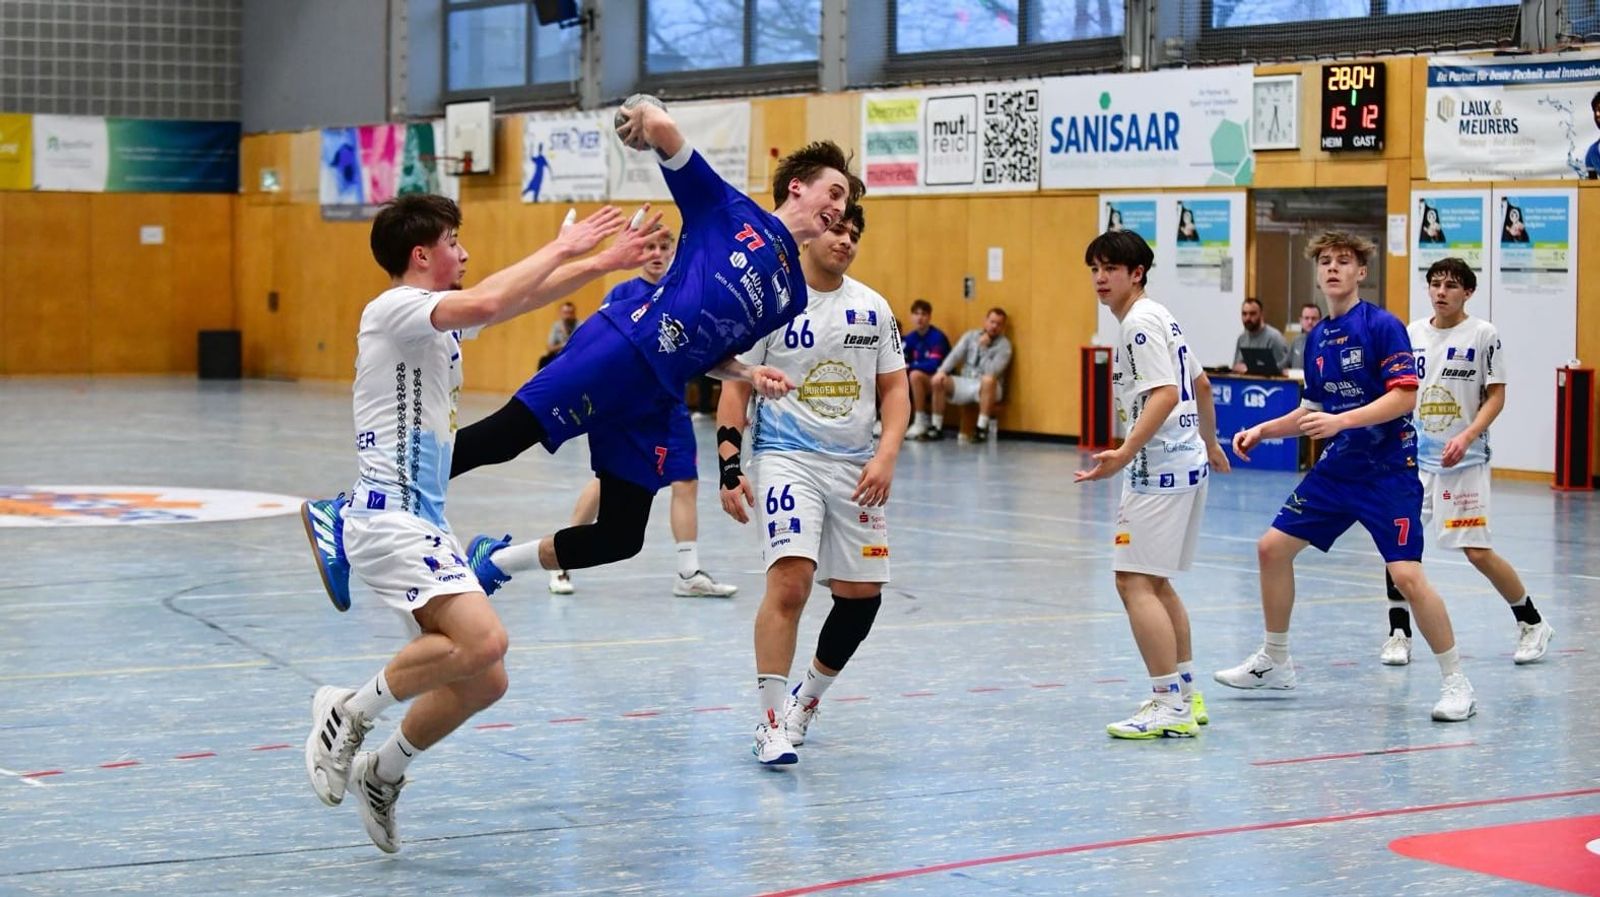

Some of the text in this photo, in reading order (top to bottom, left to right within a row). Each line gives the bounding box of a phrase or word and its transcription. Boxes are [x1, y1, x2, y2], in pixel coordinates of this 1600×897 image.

[1351, 89, 1357, 106] 1
[1331, 104, 1378, 130] 15 12
[1461, 100, 1503, 116] LAUX &
[933, 114, 965, 135] mut
[1050, 111, 1181, 154] SANISAAR
[1459, 118, 1519, 135] MEURERS
[1322, 135, 1376, 148] HEIM GAST
[735, 223, 765, 252] 77
[784, 319, 815, 349] 66
[843, 333, 880, 345] teamP
[1441, 367, 1477, 378] teamP
[1243, 393, 1266, 408] LBS
[356, 431, 376, 451] ER
[766, 484, 795, 515] 66
[1394, 517, 1410, 546] 7
